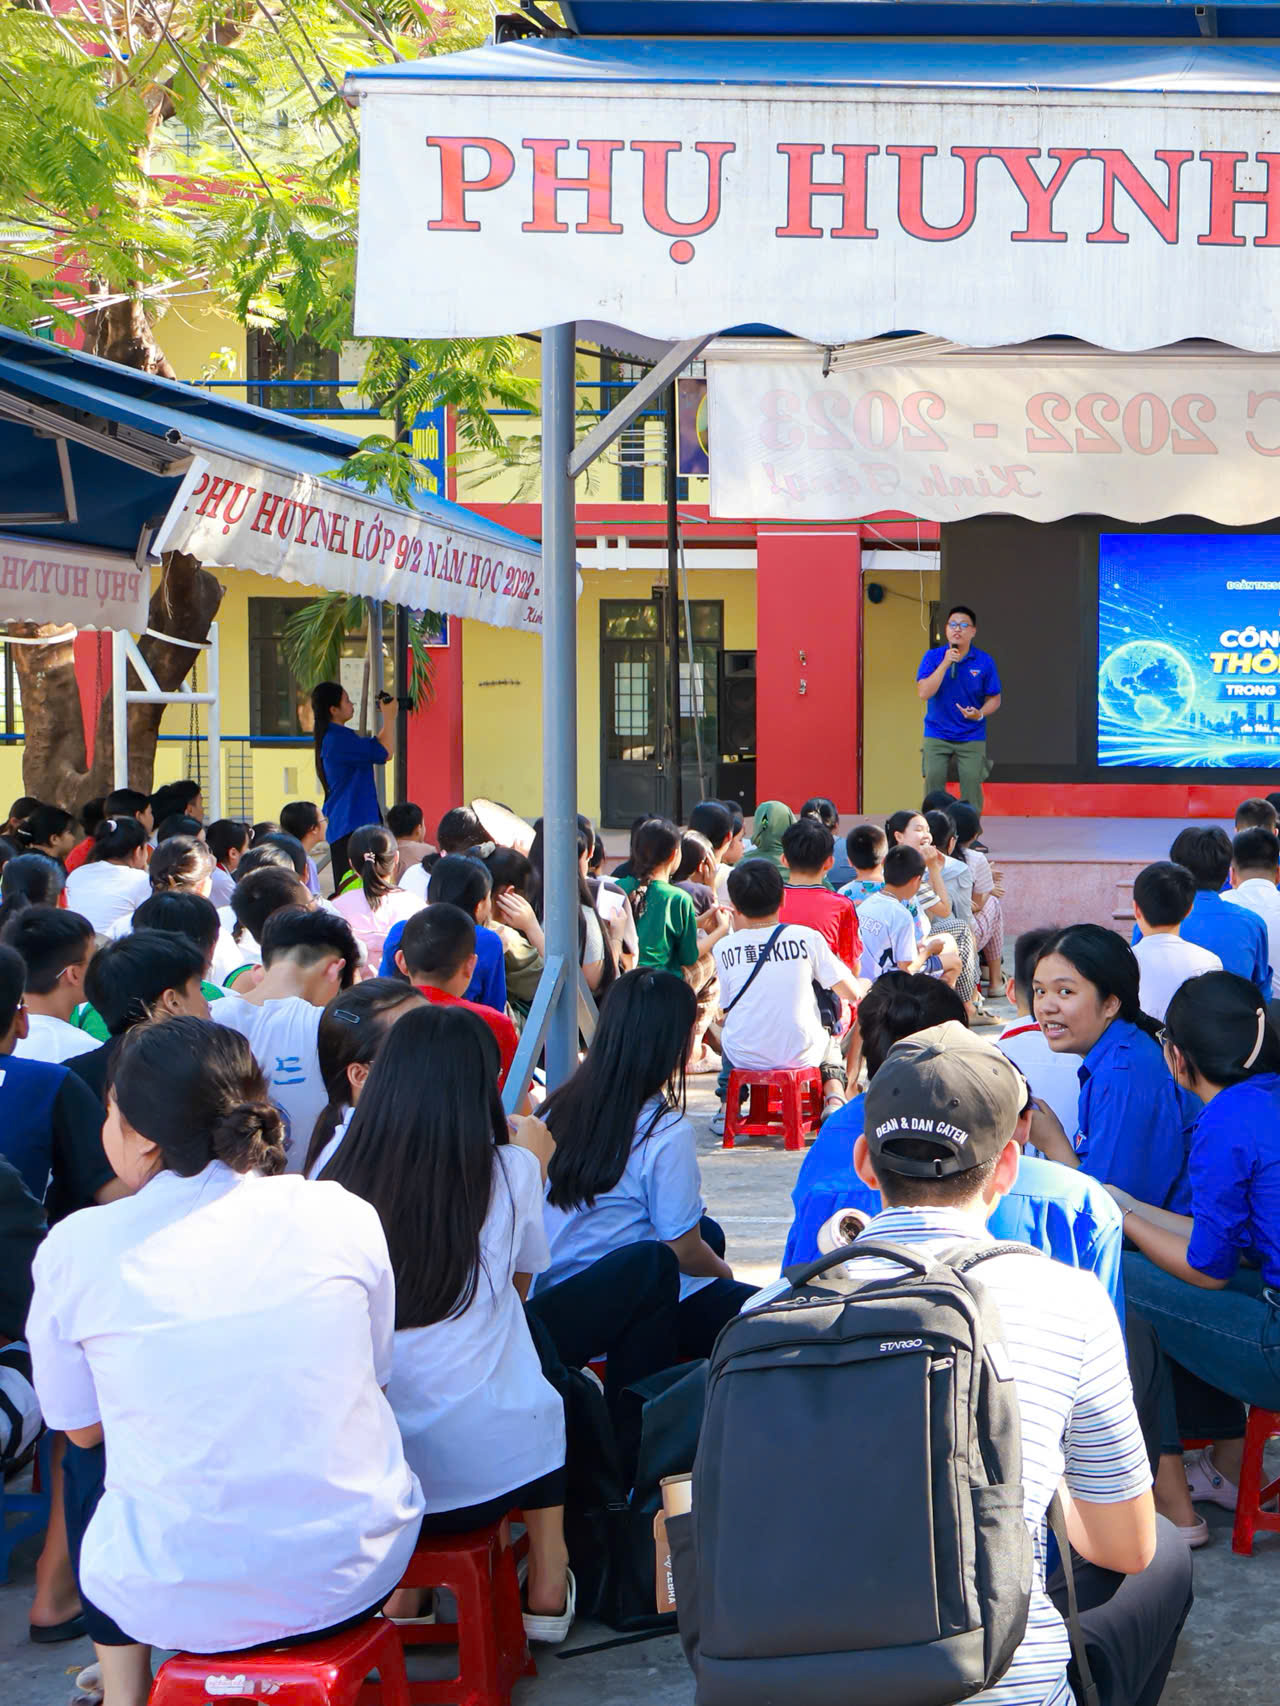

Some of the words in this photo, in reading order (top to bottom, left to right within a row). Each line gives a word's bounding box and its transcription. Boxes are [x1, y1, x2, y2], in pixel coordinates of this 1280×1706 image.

[425, 135, 736, 264] PHỤ
[250, 491, 350, 554] HUYNH
[351, 512, 396, 565] LỚP
[394, 534, 423, 573] 9/2
[424, 536, 468, 585] NĂM
[465, 553, 504, 600] HỌC
[502, 565, 535, 600] 2022
[1226, 684, 1276, 696] TRONG
[876, 1117, 899, 1138] DEAN
[900, 1117, 909, 1129] &
[911, 1118, 934, 1132] DAN
[935, 1121, 969, 1144] CATEN
[880, 1338, 923, 1351] STARGO
